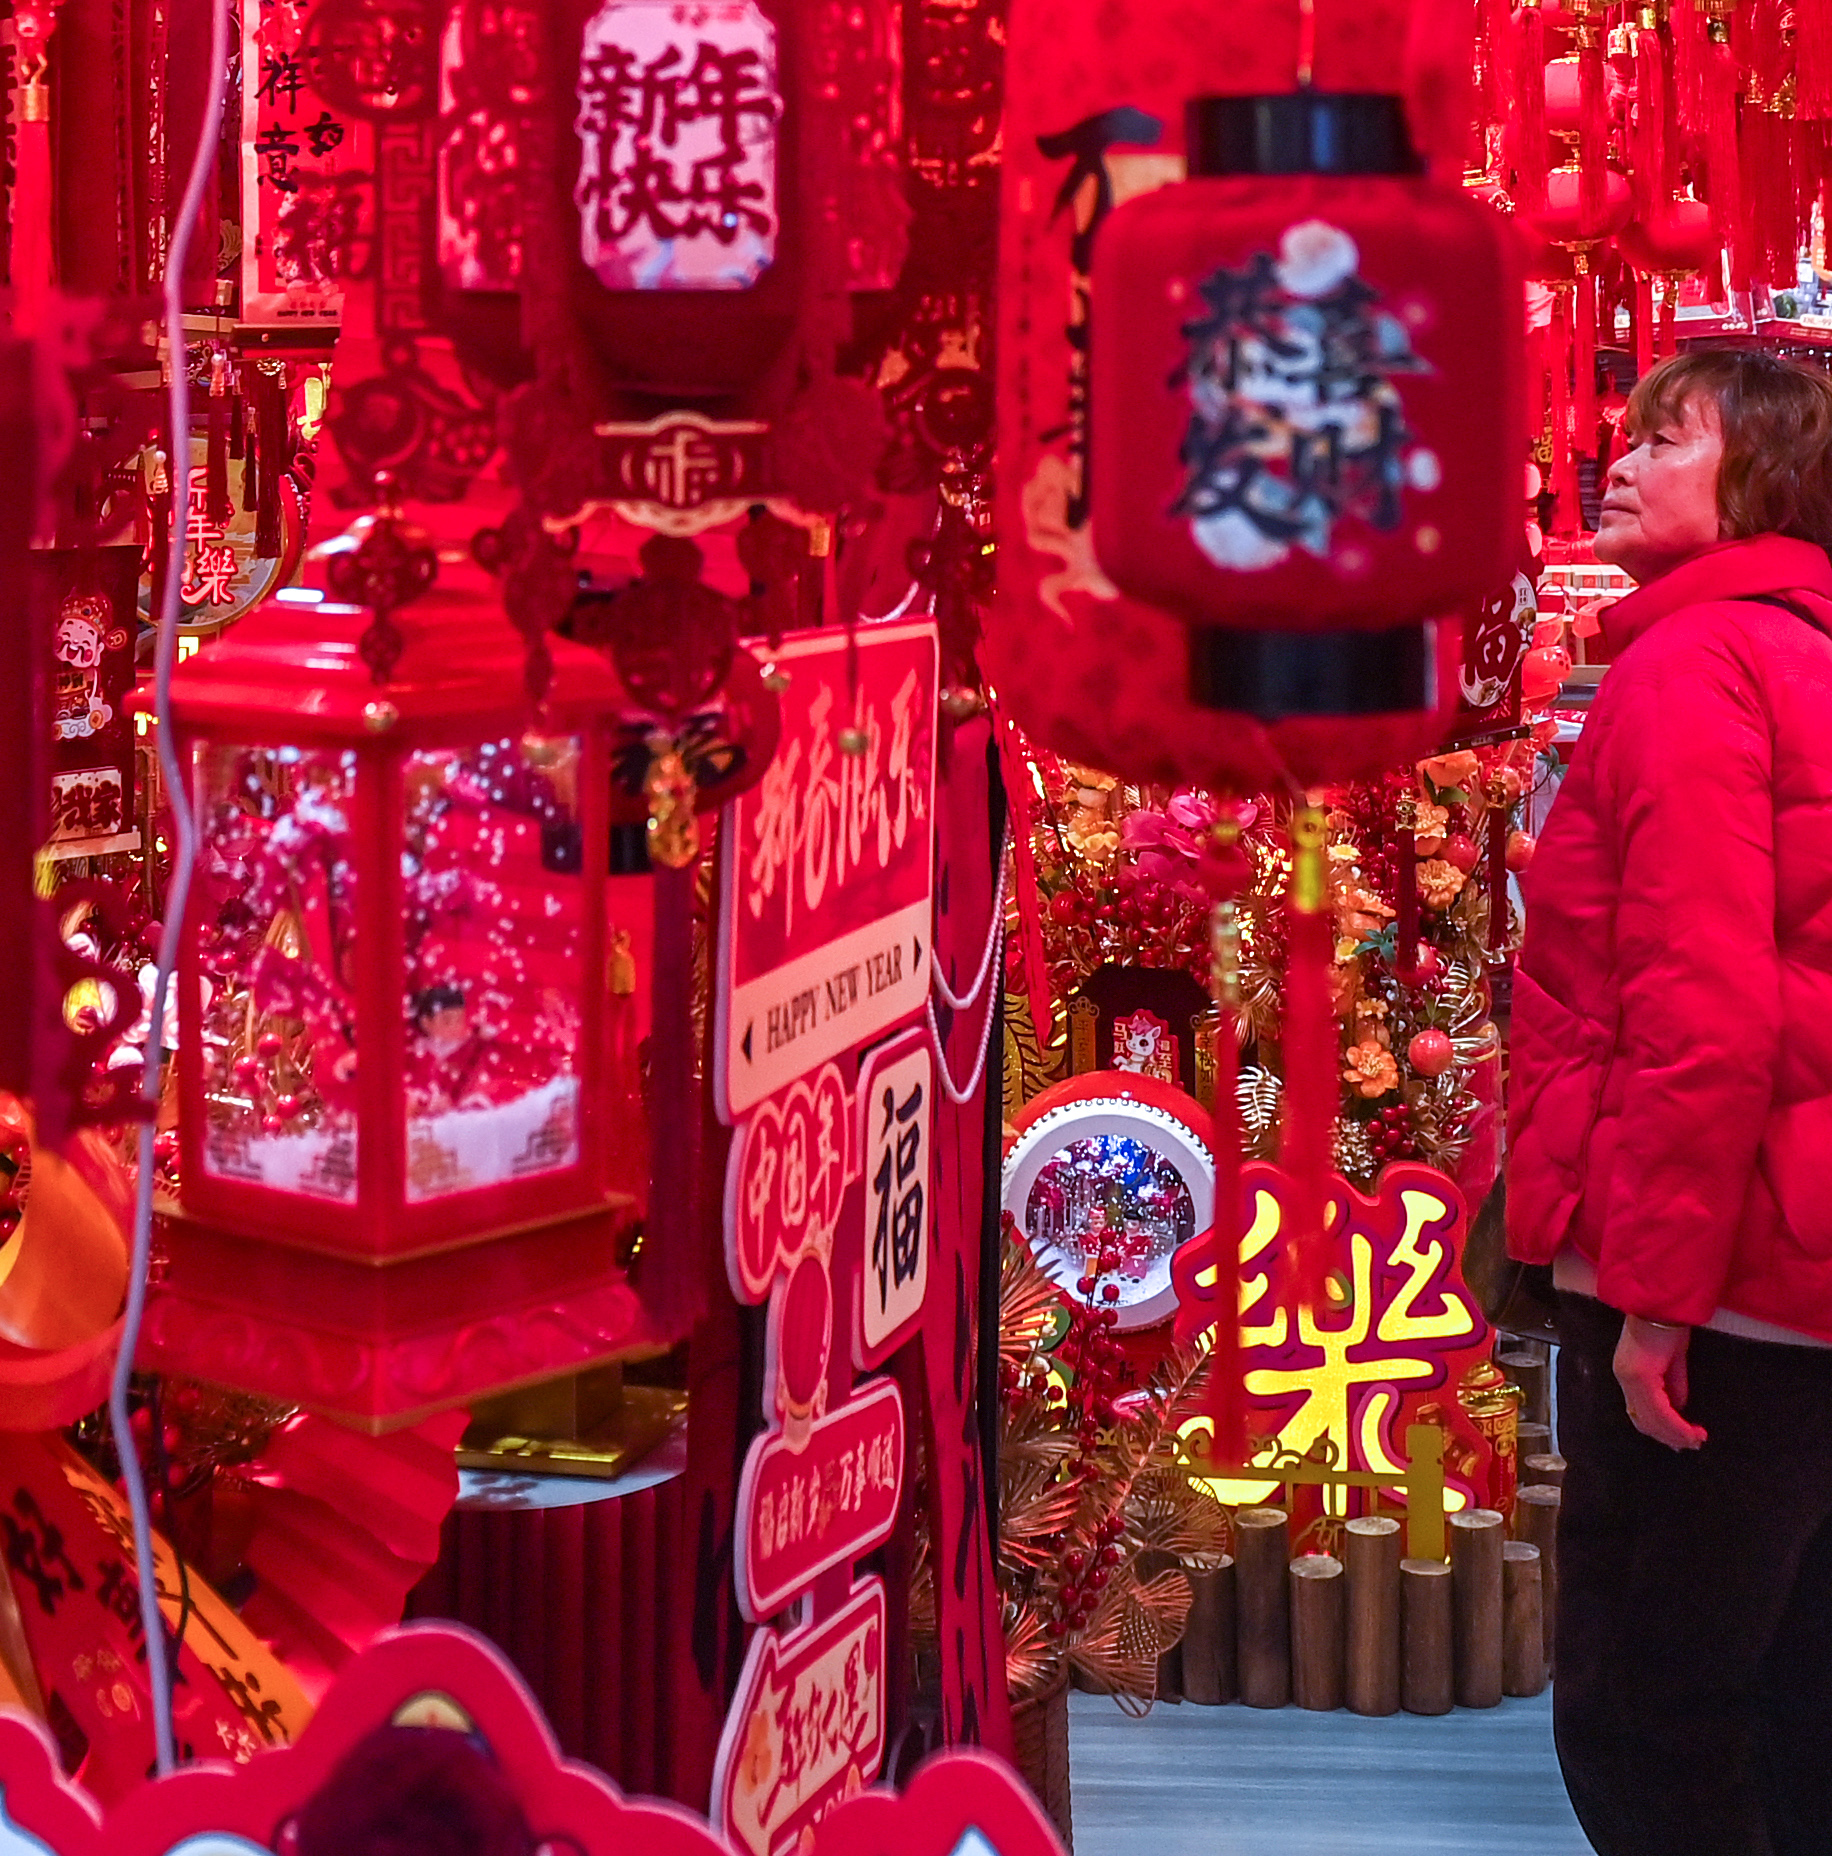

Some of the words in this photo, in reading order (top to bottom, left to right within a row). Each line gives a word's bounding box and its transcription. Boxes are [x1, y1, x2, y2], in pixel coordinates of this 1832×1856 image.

[578, 39, 778, 146] 新年
[581, 148, 770, 243] 快乐
[765, 984, 819, 1051] HAPPY
[823, 964, 864, 1016] NEW
[868, 944, 903, 1002] YEAR
[743, 1081, 843, 1256] 中国年
[873, 1082, 926, 1315] 福
